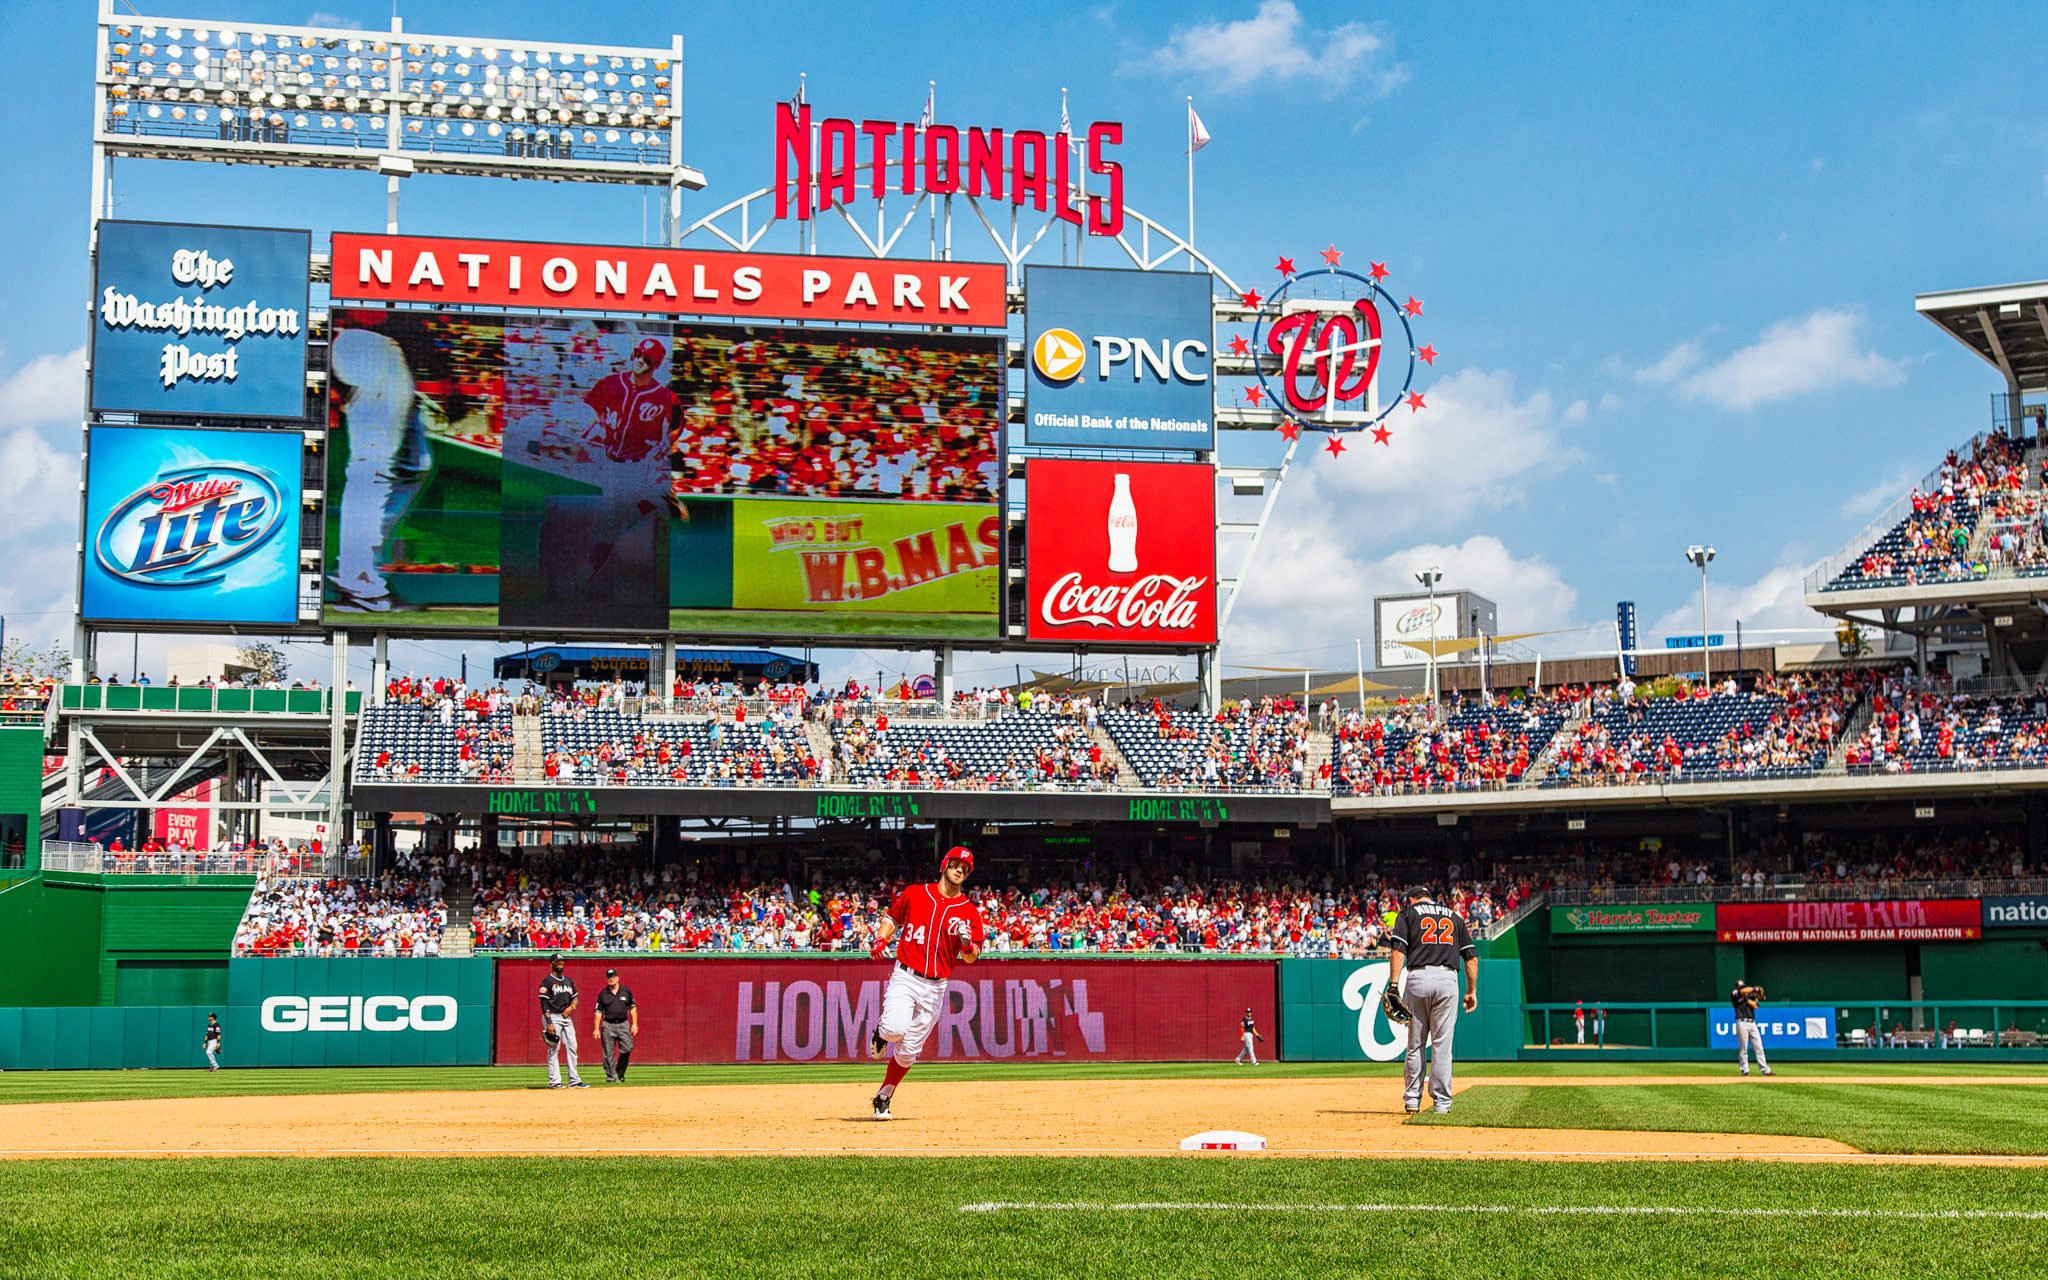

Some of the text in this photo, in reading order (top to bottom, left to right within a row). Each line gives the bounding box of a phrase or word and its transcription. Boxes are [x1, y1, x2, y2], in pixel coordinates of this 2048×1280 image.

[775, 101, 1123, 236] NATIONALS
[172, 249, 234, 288] The
[358, 248, 971, 310] NATIONALS PARK
[101, 286, 300, 340] Washington
[160, 343, 239, 386] Post
[1093, 336, 1208, 381] PNC
[1035, 413, 1208, 433] Official Bank of the Nationals
[150, 480, 243, 508] Miller
[124, 496, 267, 575] Lite
[1042, 572, 1208, 628] Coca-Cola
[1691, 636, 1720, 647] SMKE
[591, 656, 731, 672] SCOREBD WALK
[1115, 665, 1181, 682] SHACK
[489, 791, 540, 813] HOME
[816, 795, 866, 816] HOME
[1129, 799, 1176, 820] HOME
[168, 813, 197, 828] EVERY
[168, 827, 197, 845] PLAY
[1414, 905, 1453, 917] MURPHY
[1588, 909, 1701, 925] Harris Teeter
[1788, 902, 1857, 929] HOME
[905, 923, 925, 945] 34
[1421, 917, 1454, 945] 22
[1736, 928, 1962, 941] WASHINGTON NATIONALS DREAM FOUNDATION
[260, 995, 458, 1031] GEICO
[735, 980, 890, 1060] HOM
[1716, 1023, 1800, 1035] UTED
